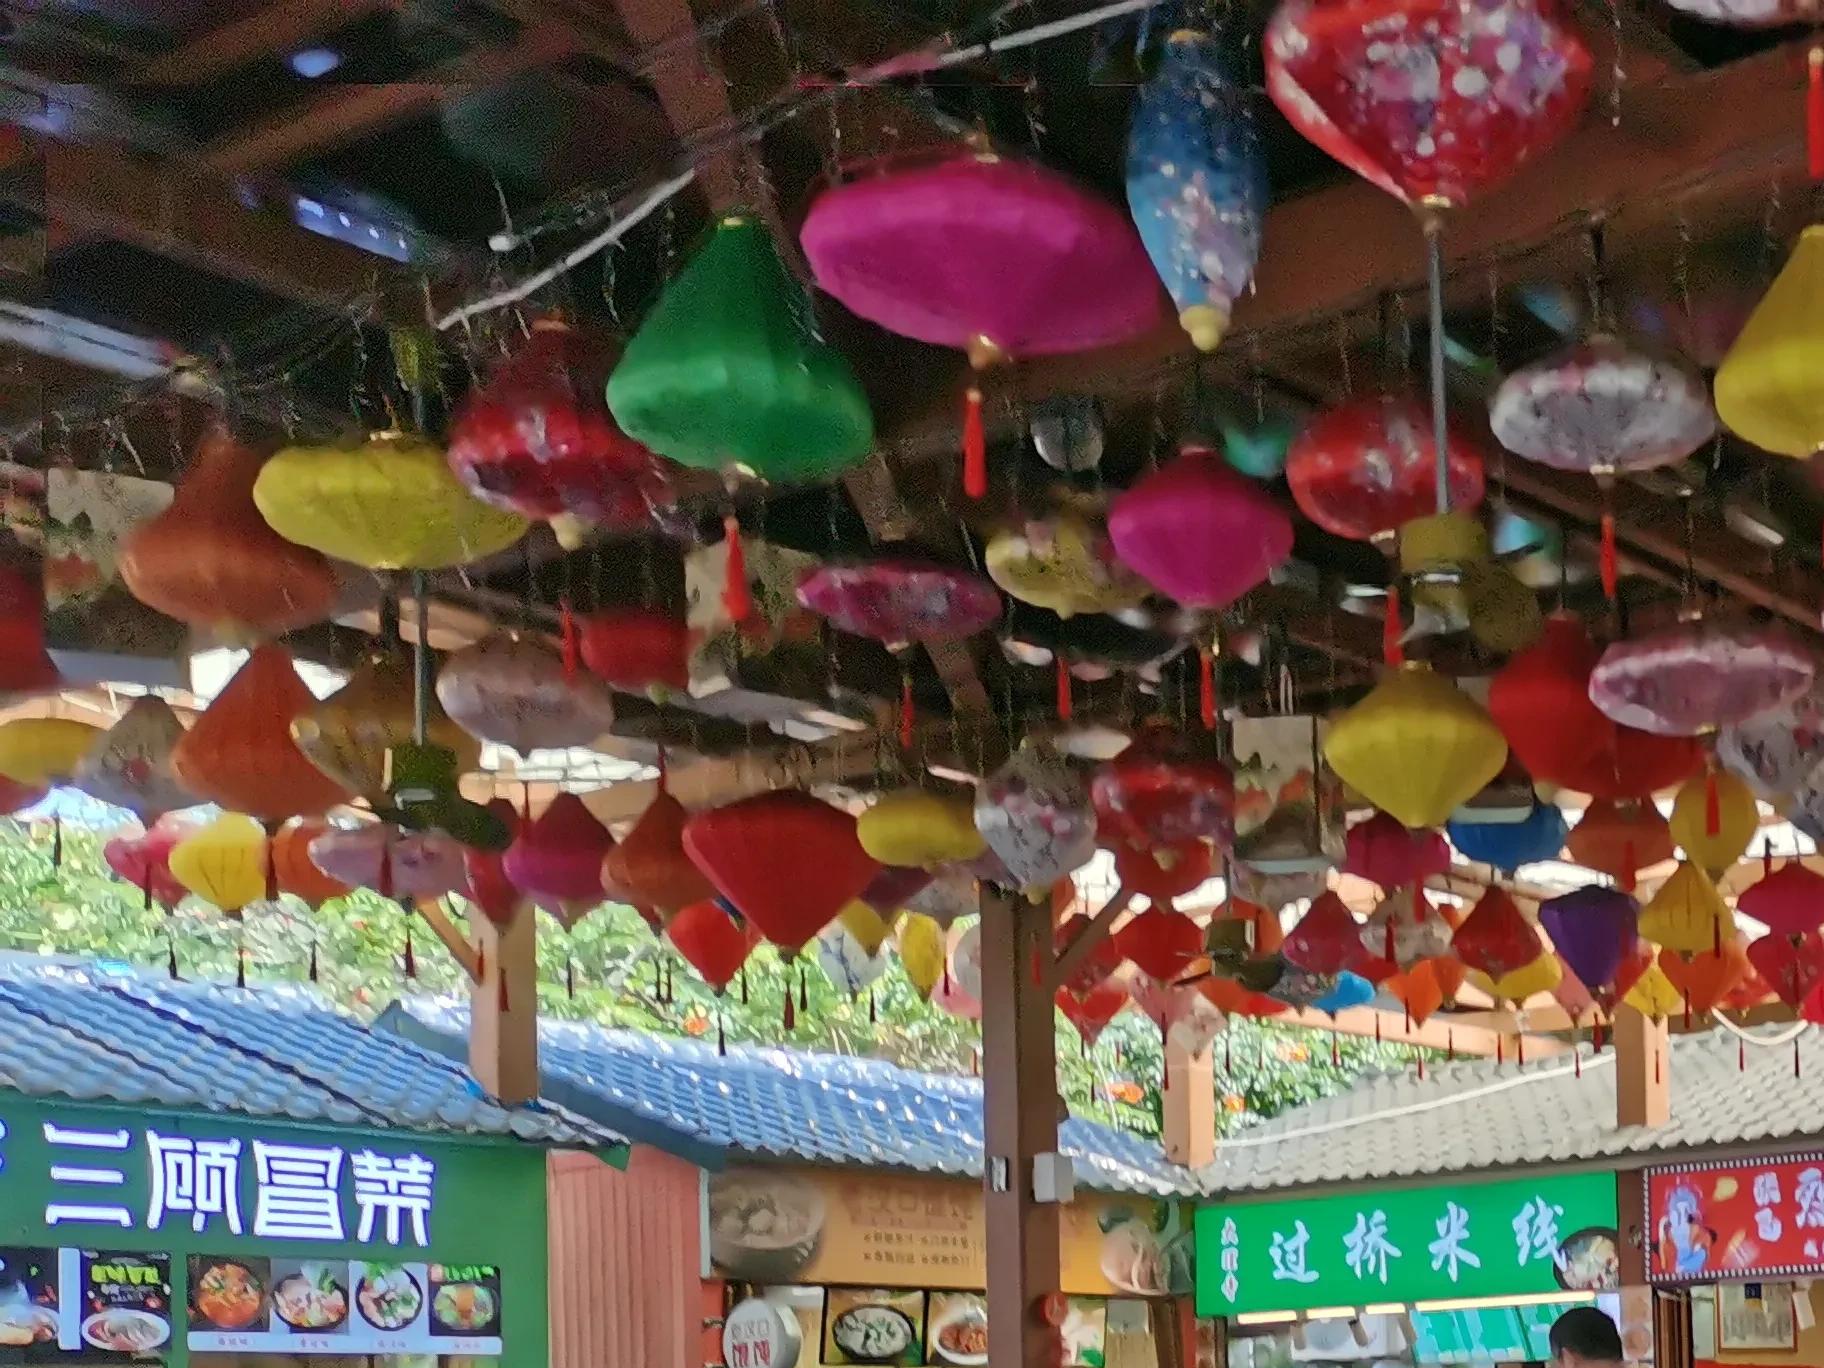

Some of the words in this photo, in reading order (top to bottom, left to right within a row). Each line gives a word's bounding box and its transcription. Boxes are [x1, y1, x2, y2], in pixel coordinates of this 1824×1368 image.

[43, 1121, 436, 1247] 三顾冒菜
[1268, 1194, 1568, 1286] 过桥米线
